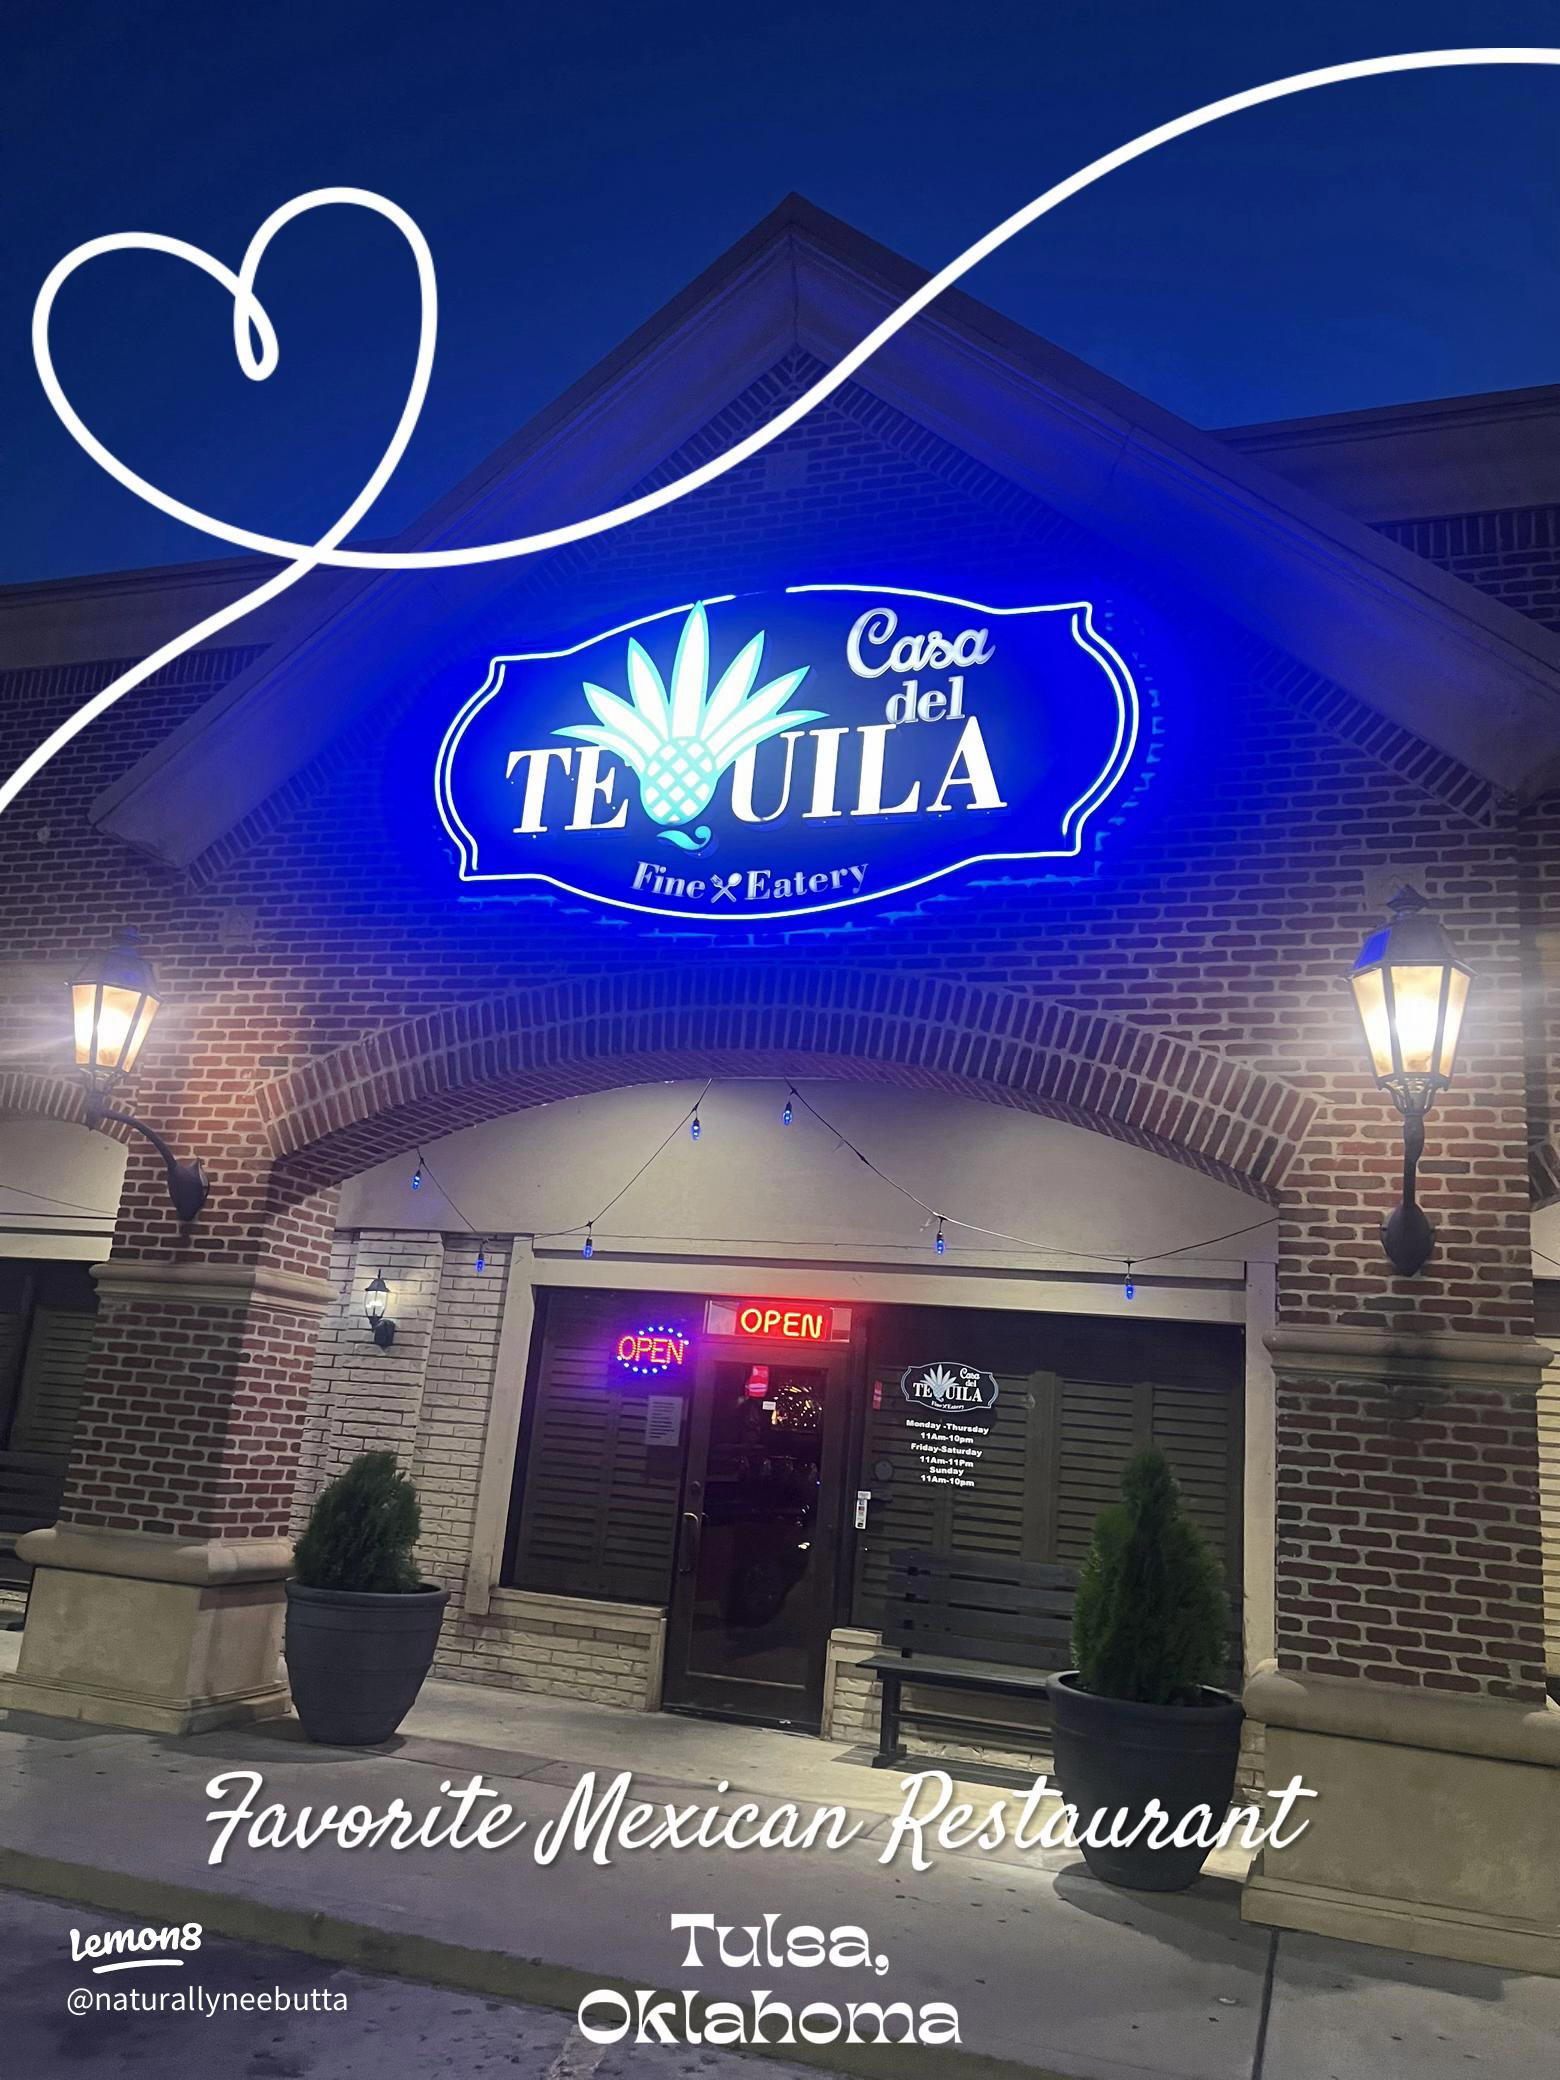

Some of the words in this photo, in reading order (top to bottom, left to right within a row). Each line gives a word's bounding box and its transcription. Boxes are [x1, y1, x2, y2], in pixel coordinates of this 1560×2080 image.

[846, 607, 995, 679] Casa
[886, 677, 966, 724] del
[630, 860, 706, 900] Fine
[744, 862, 870, 901] Eatery
[740, 1307, 823, 1339] OPEN
[617, 1335, 684, 1364] OPEN
[960, 1368, 980, 1380] Casa
[966, 1380, 977, 1388] del
[906, 1420, 941, 1430] Monday
[911, 1443, 982, 1458] Friday-Saturday
[929, 1466, 964, 1476] Sunday
